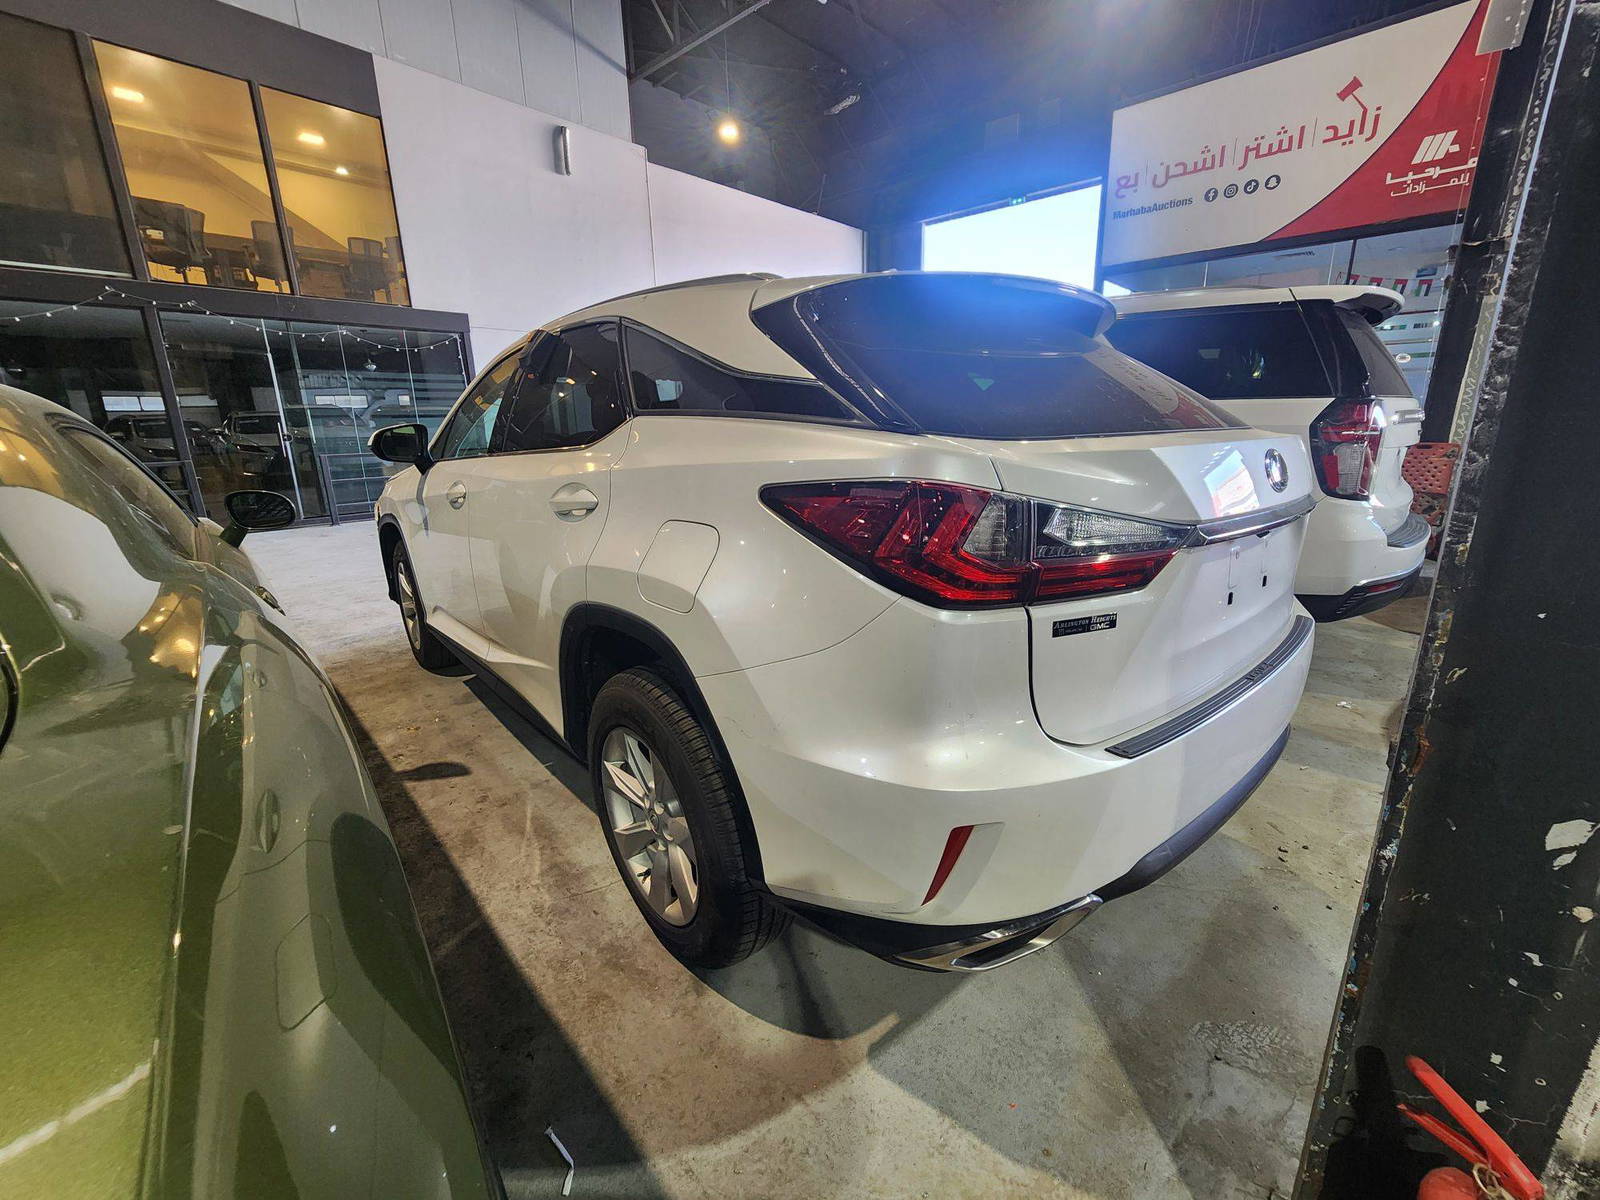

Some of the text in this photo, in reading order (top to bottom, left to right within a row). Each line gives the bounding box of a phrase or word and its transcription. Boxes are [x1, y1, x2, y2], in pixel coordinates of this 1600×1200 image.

[1114, 104, 1382, 200] زايد اشتر اشحن بع
[1385, 156, 1479, 185] مرحبا
[1390, 172, 1470, 197] للمزادات
[1112, 196, 1193, 220] MarhabaAuctions
[1090, 621, 1110, 630] GMC
